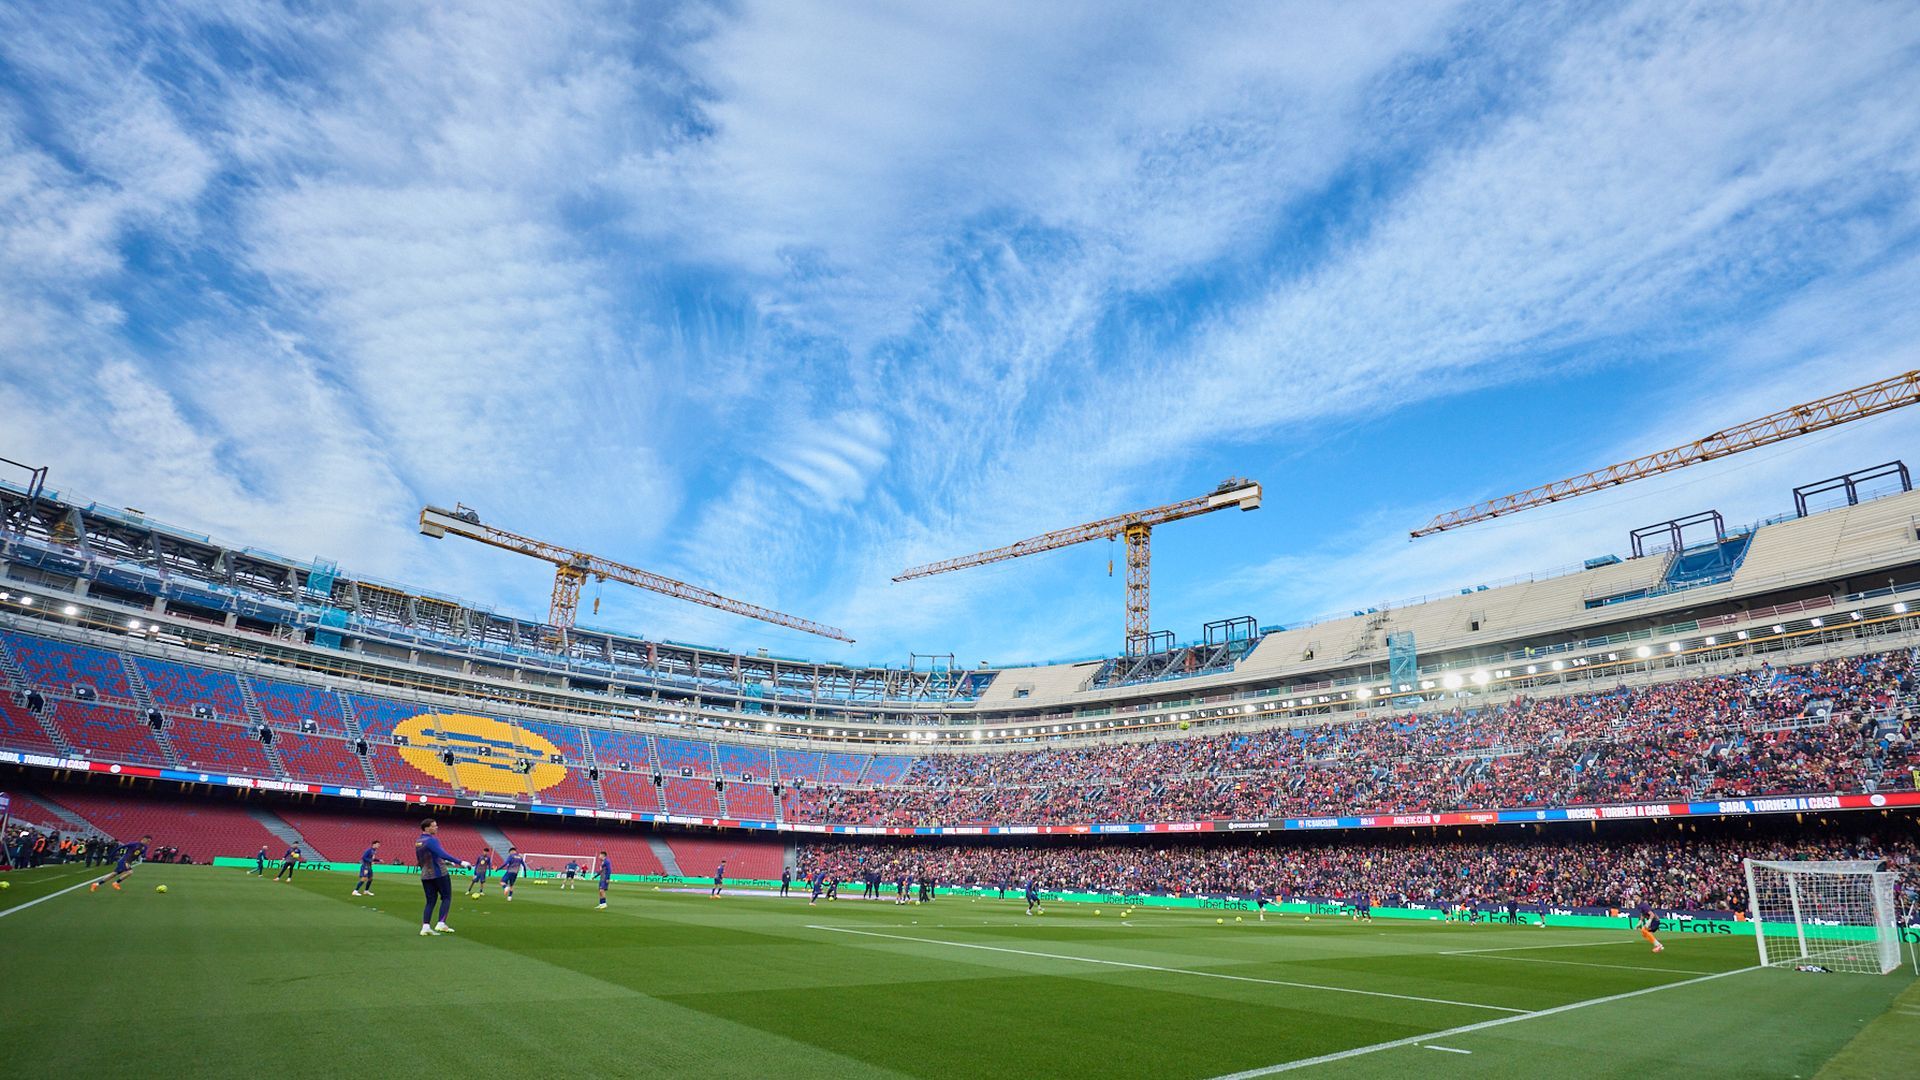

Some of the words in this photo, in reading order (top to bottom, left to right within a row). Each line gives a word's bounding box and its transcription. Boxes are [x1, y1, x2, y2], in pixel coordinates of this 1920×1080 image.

[1719, 801, 1750, 813] SARA,
[1752, 799, 1798, 811] TORNEM
[1799, 798, 1808, 809] A
[1808, 796, 1840, 809] CASA
[1566, 808, 1599, 819] VICENÇ,
[1600, 806, 1636, 818] TORNEM
[1637, 806, 1644, 816] A
[1645, 805, 1670, 816] CASA
[1199, 899, 1221, 908] Uber
[1224, 900, 1248, 910] Eats
[1310, 905, 1337, 915] Uber
[1679, 920, 1731, 934] Eats
